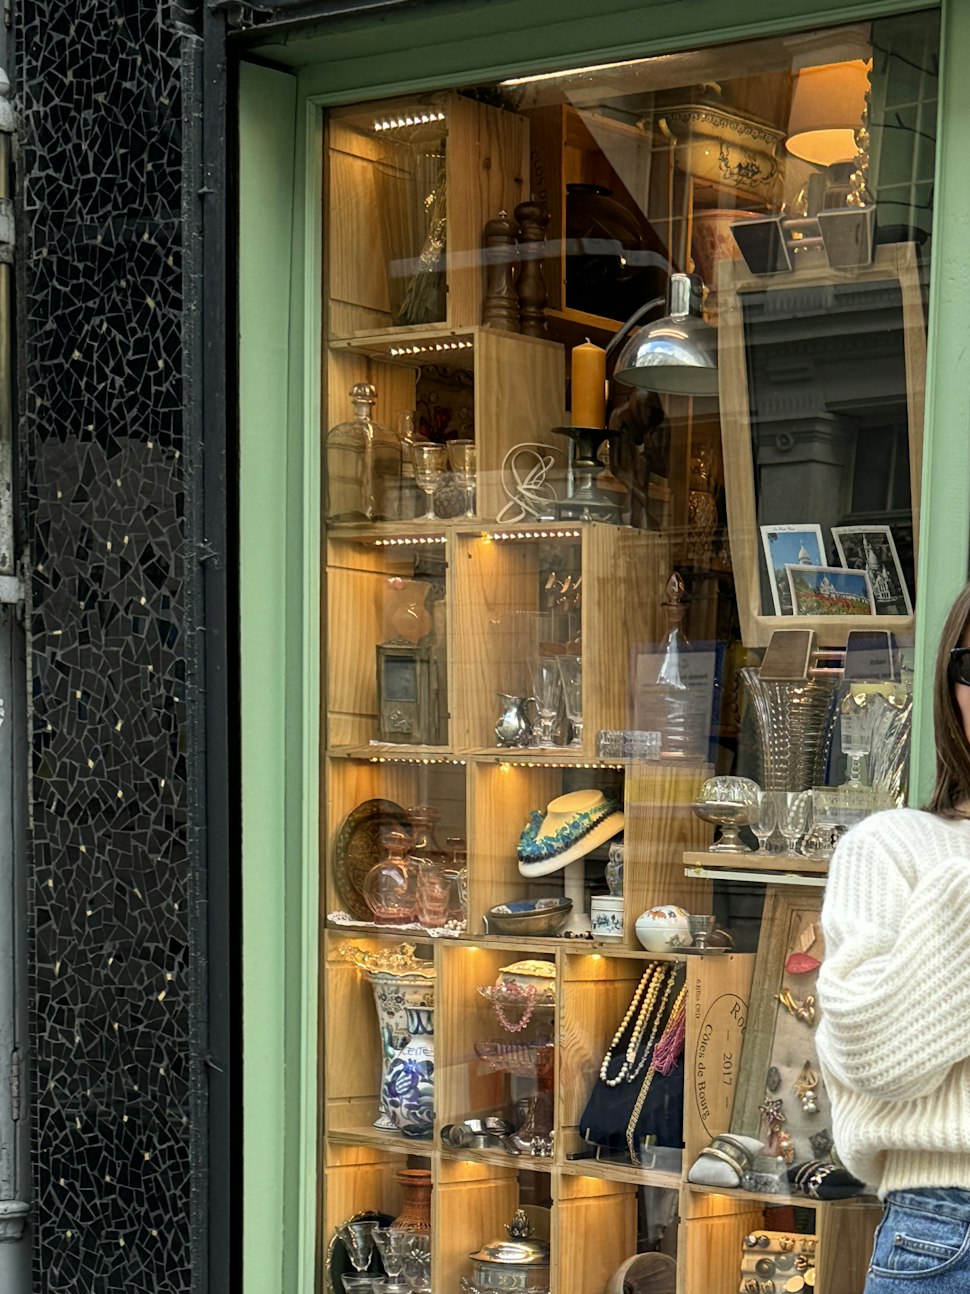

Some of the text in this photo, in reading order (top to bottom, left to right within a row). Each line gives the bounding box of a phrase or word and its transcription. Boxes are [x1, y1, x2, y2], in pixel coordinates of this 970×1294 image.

[697, 1023, 714, 1121] Côtes de Bourg
[722, 1052, 733, 1086] 2017
